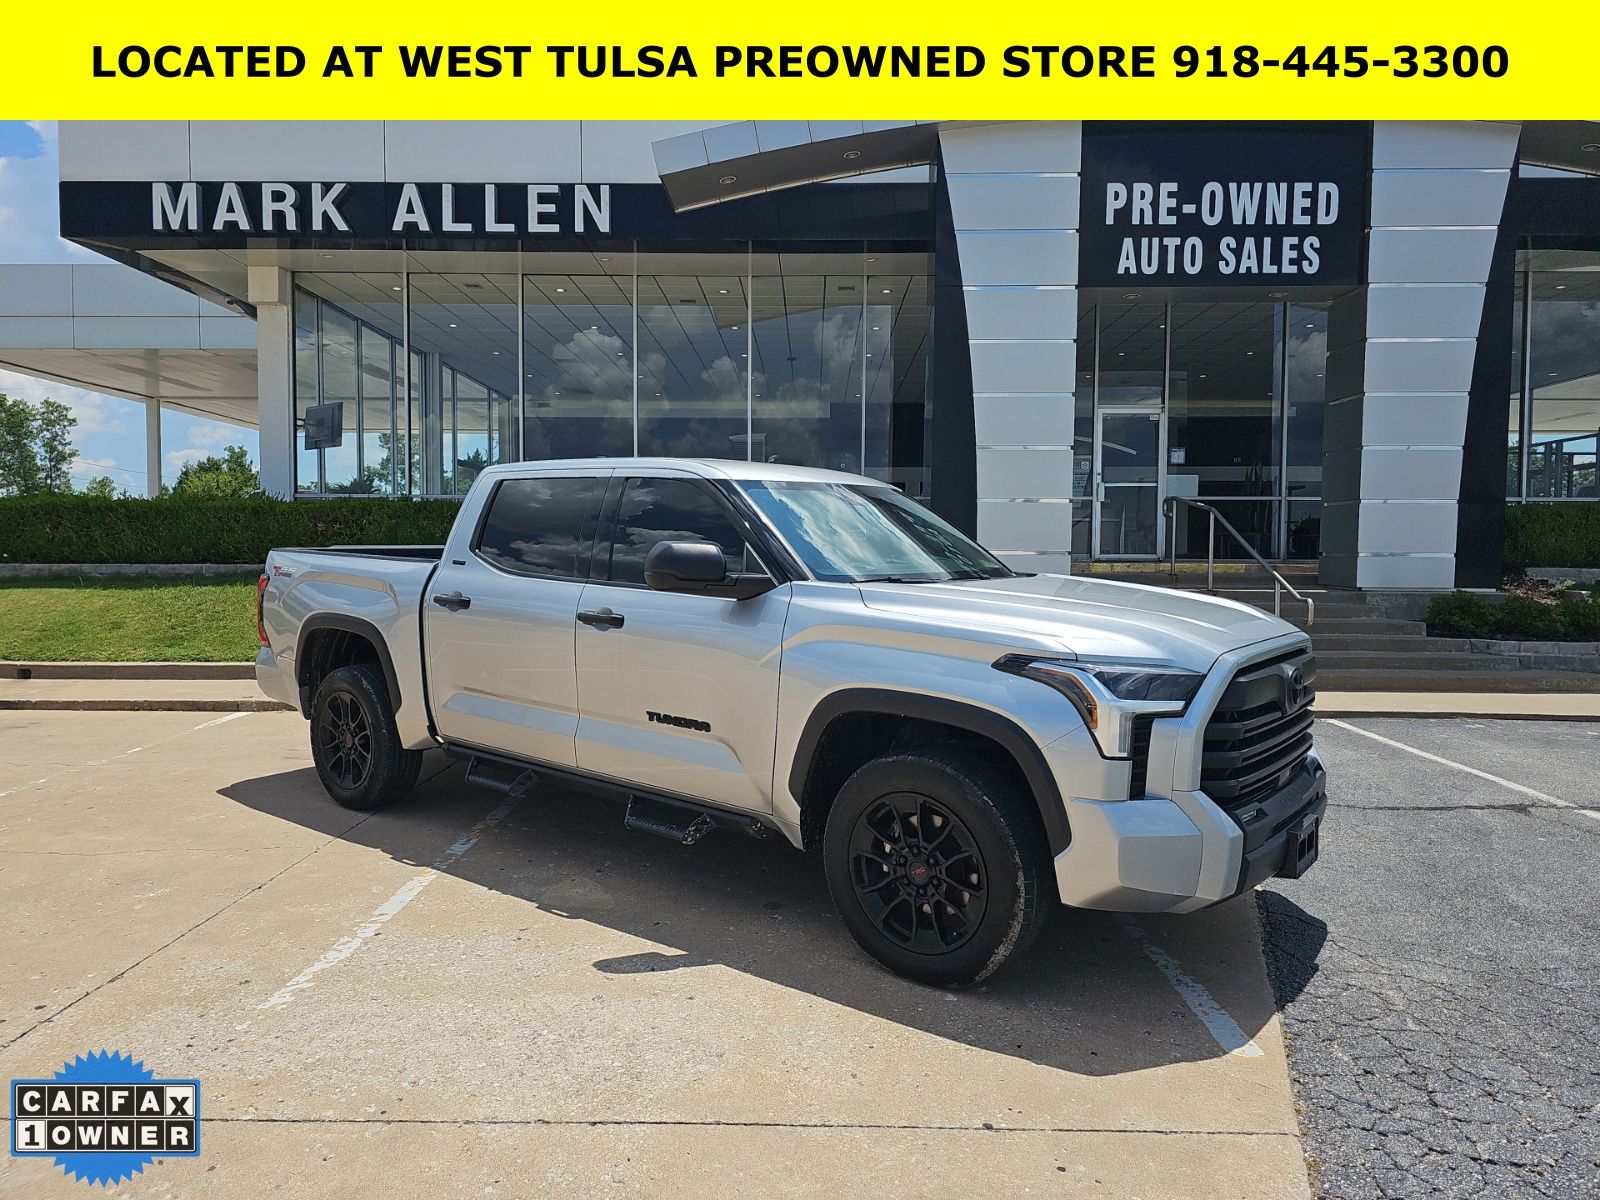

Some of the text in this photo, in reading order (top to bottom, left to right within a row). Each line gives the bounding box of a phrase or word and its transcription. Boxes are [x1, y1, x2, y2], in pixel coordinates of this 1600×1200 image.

[151, 182, 612, 233] MARK ALLEN
[1105, 181, 1340, 227] PRE-OWNED
[1117, 235, 1321, 275] AUTO SALES
[645, 710, 711, 733] TUNDRA
